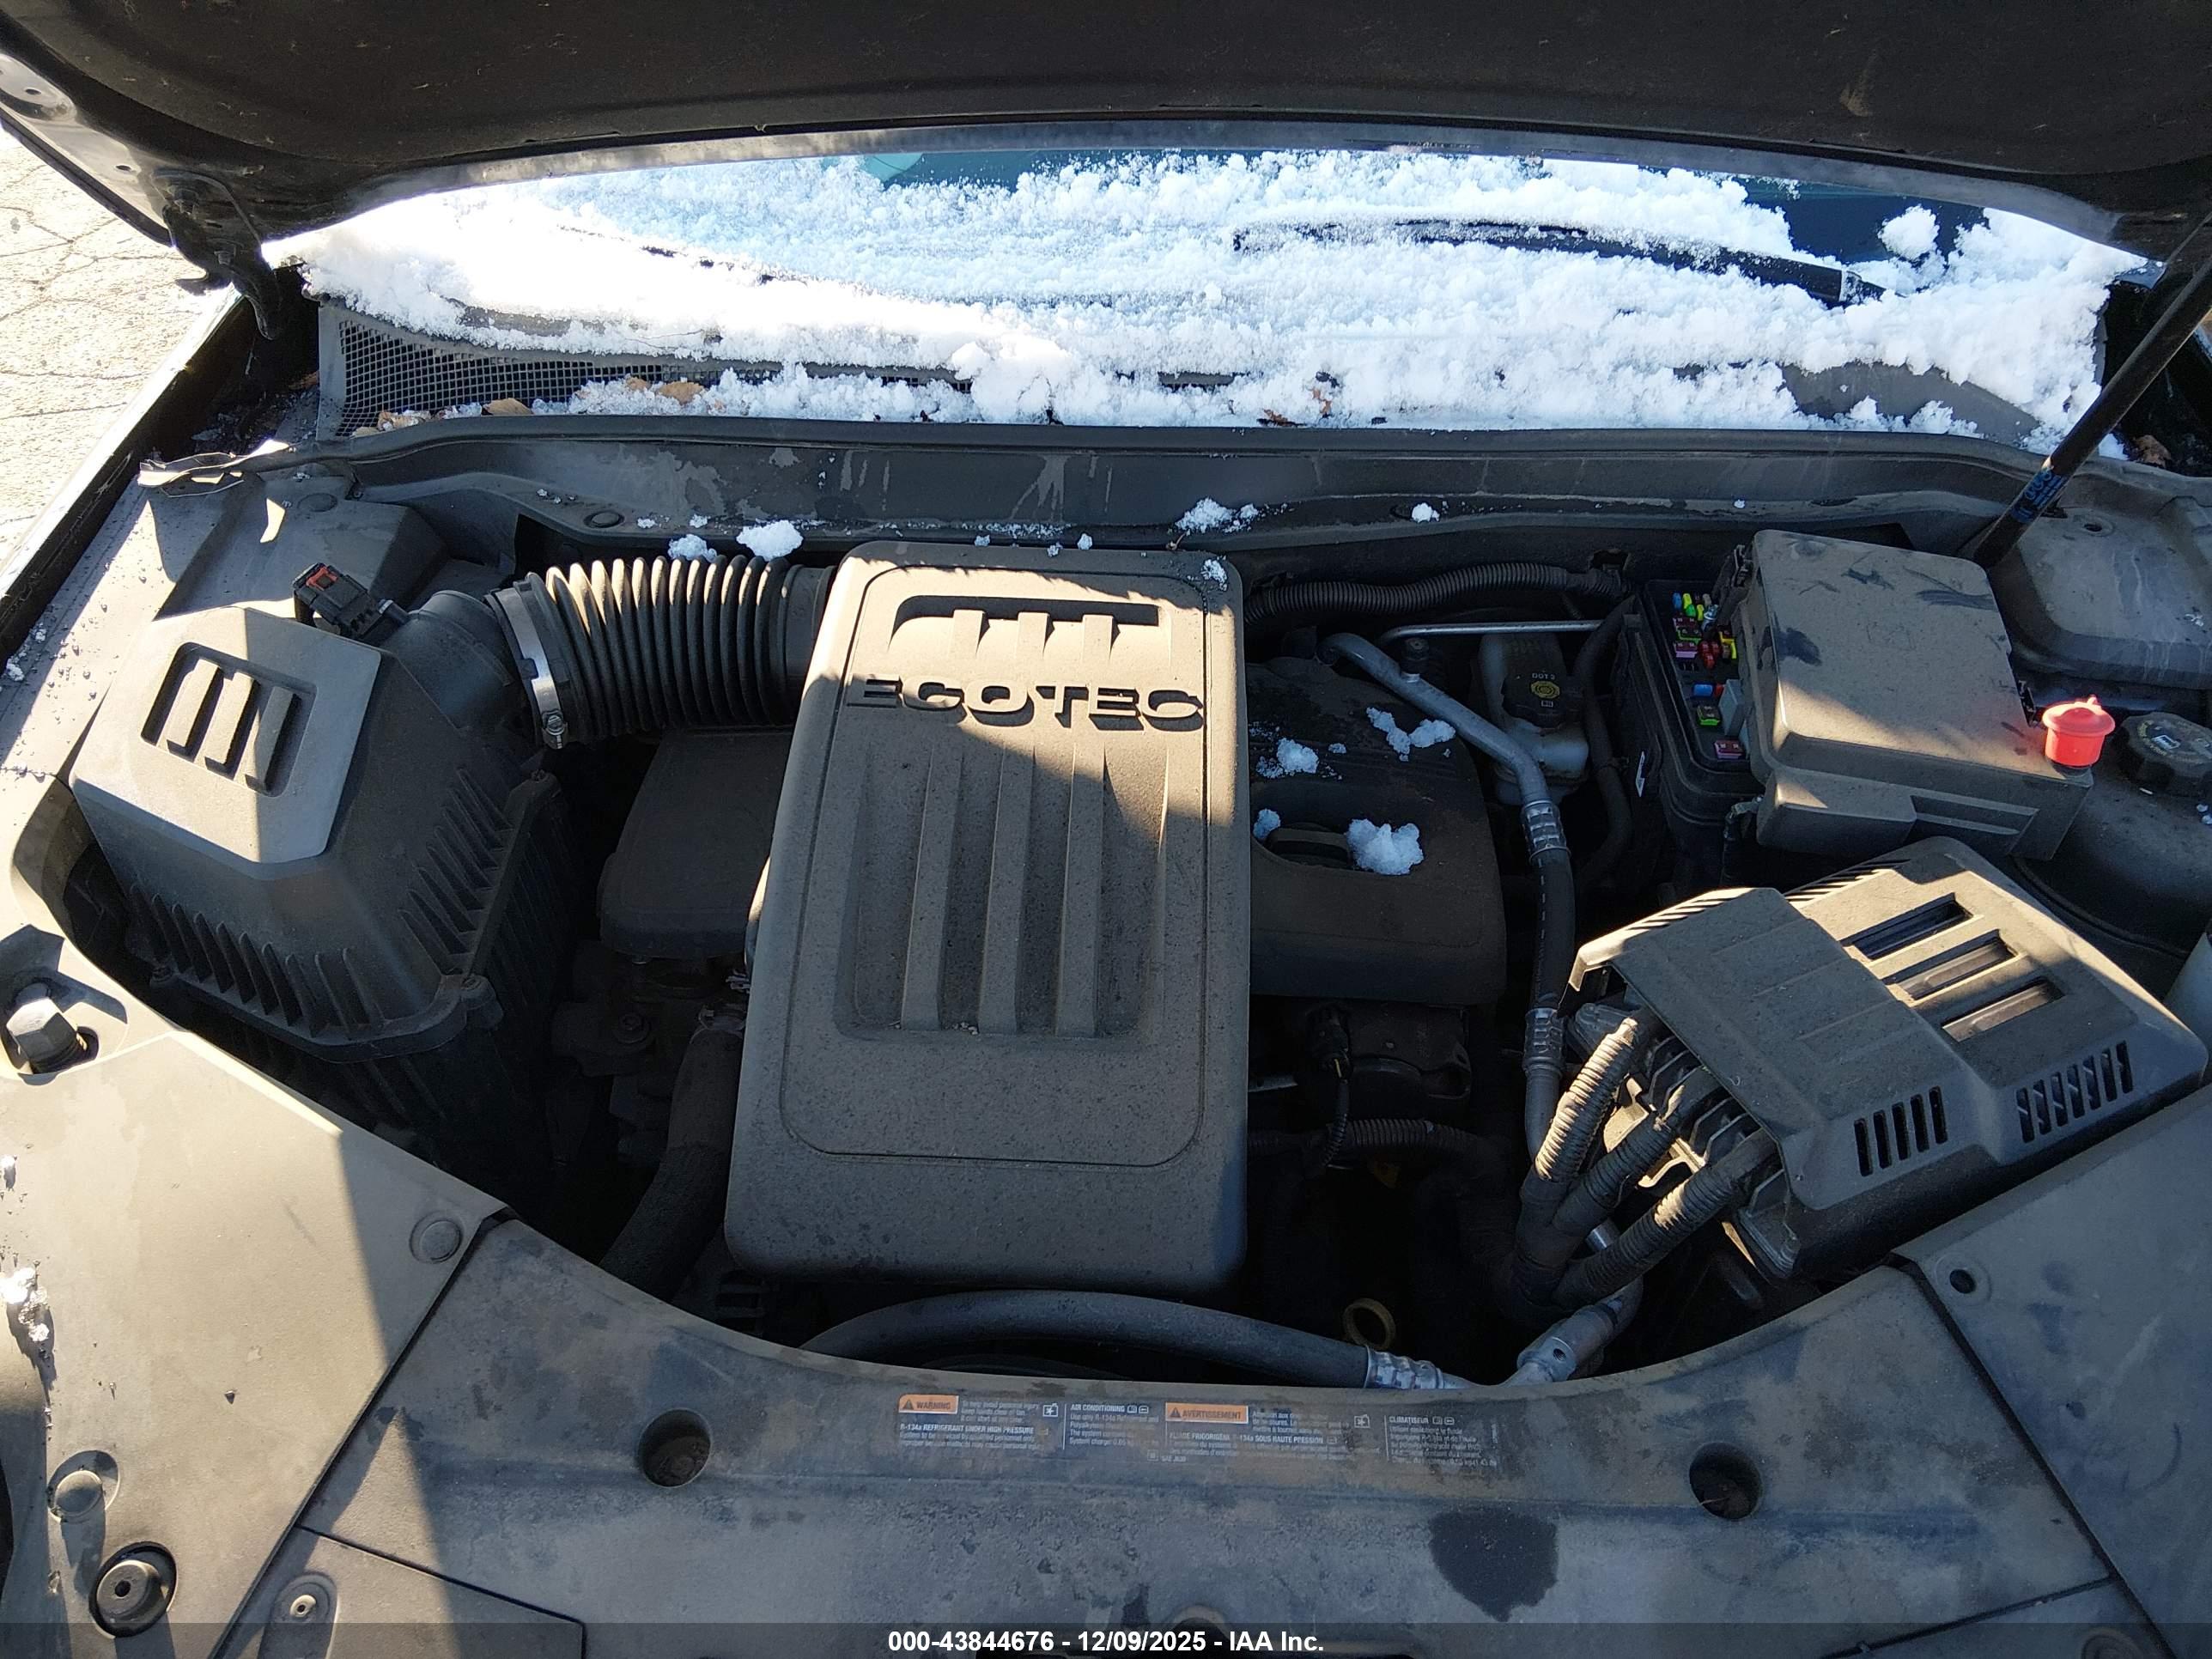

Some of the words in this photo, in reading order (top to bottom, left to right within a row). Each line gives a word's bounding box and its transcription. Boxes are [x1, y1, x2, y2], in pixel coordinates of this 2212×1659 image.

[846, 672, 1205, 730] ECOTEC
[915, 1401, 951, 1410] WARNING
[1082, 1403, 1125, 1412] CONDITIONING
[1182, 1409, 1242, 1419] AVERTISSEMENT
[1255, 1434, 1272, 1443] SOUS
[1293, 1436, 1324, 1444] PRESSION
